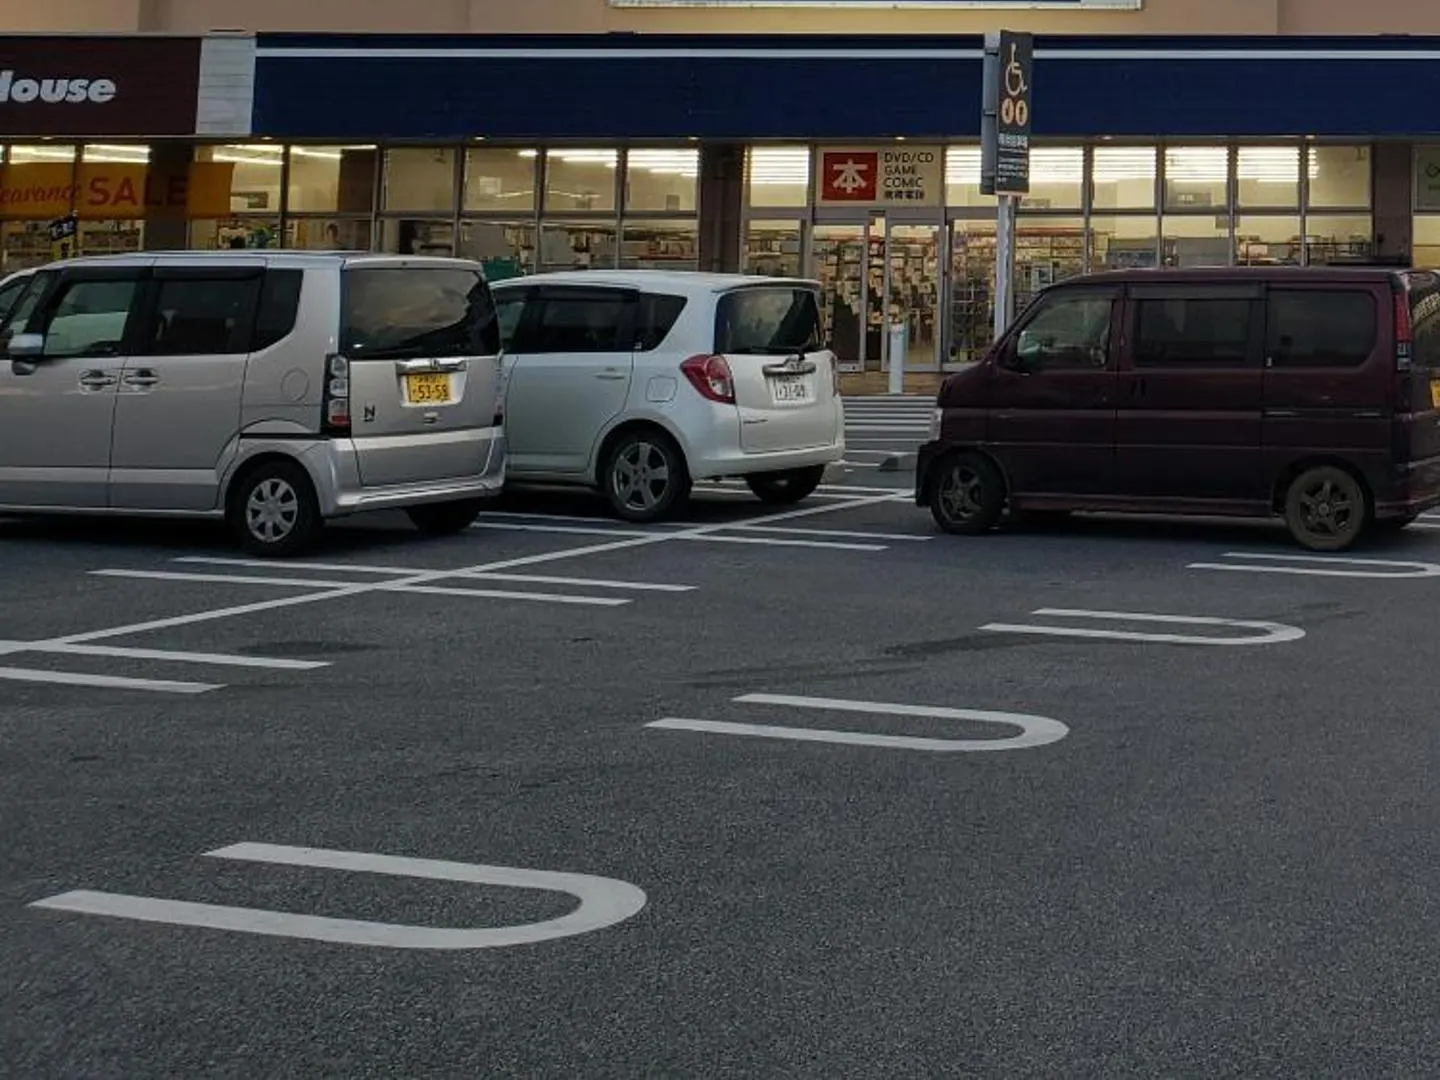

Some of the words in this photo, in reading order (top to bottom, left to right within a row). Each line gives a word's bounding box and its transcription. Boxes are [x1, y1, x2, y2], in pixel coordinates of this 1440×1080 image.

[883, 152, 934, 163] DVD/CD
[833, 159, 868, 194] 本
[883, 177, 924, 188] COMIC
[87, 176, 188, 206] SALE
